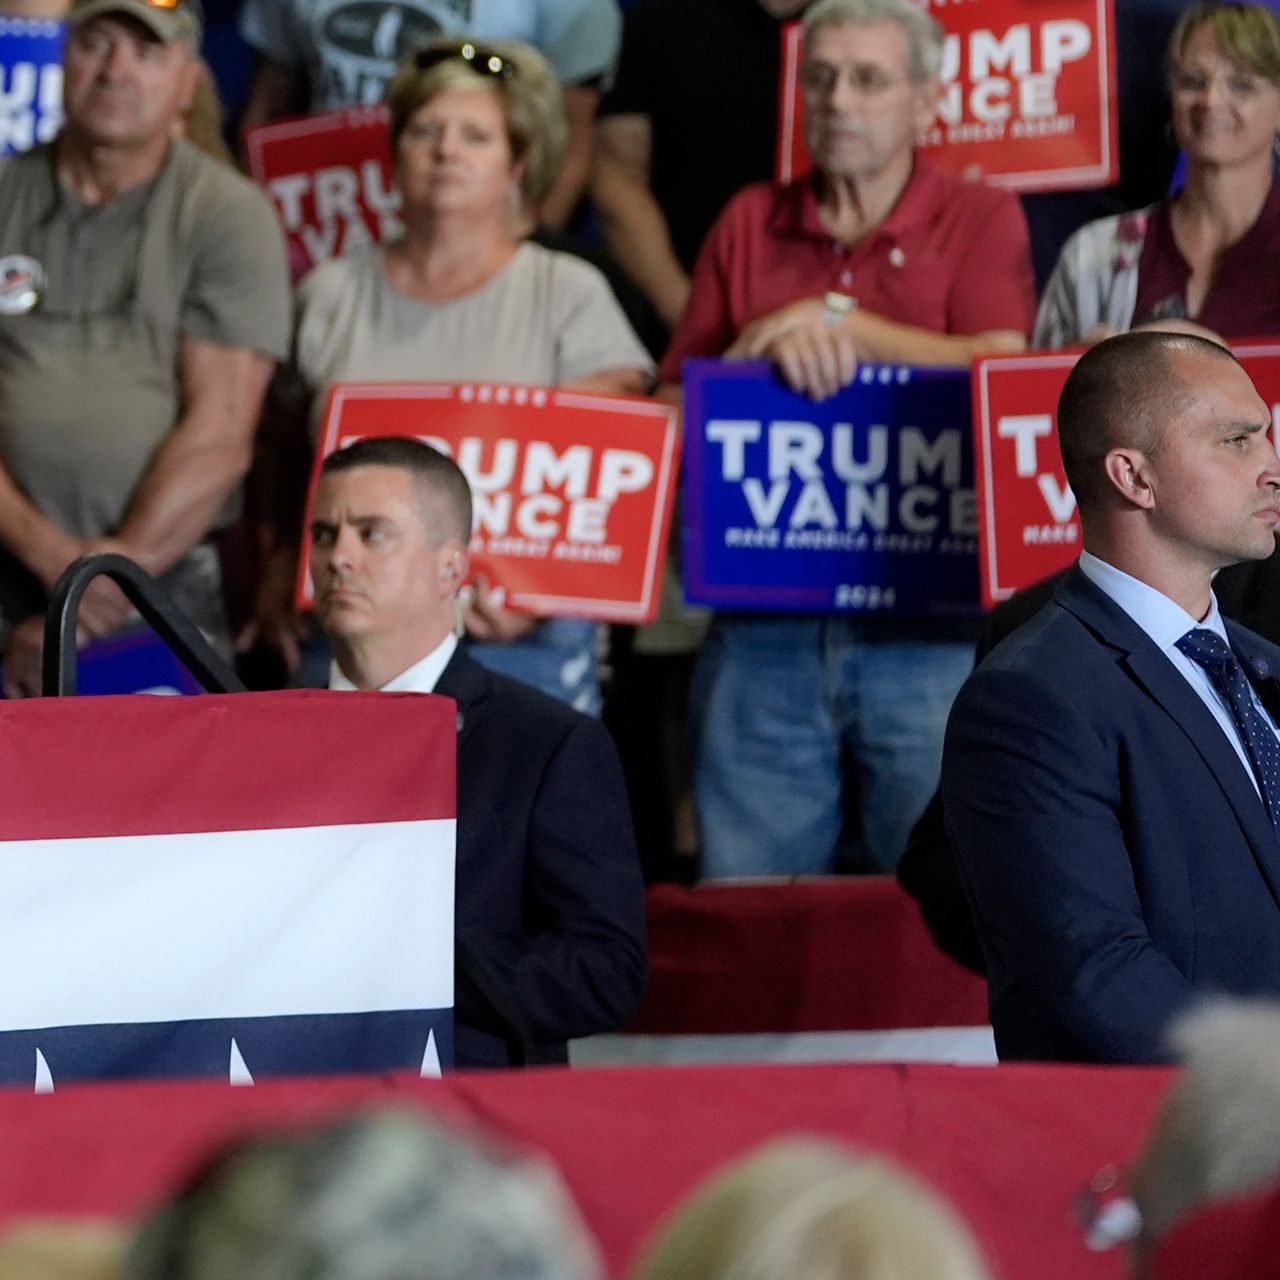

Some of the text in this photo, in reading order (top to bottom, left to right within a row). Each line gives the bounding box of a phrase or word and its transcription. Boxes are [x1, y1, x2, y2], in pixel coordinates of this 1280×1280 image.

[430, 436, 654, 505] UMP
[705, 419, 963, 488] TRUM
[471, 490, 614, 544] NCE
